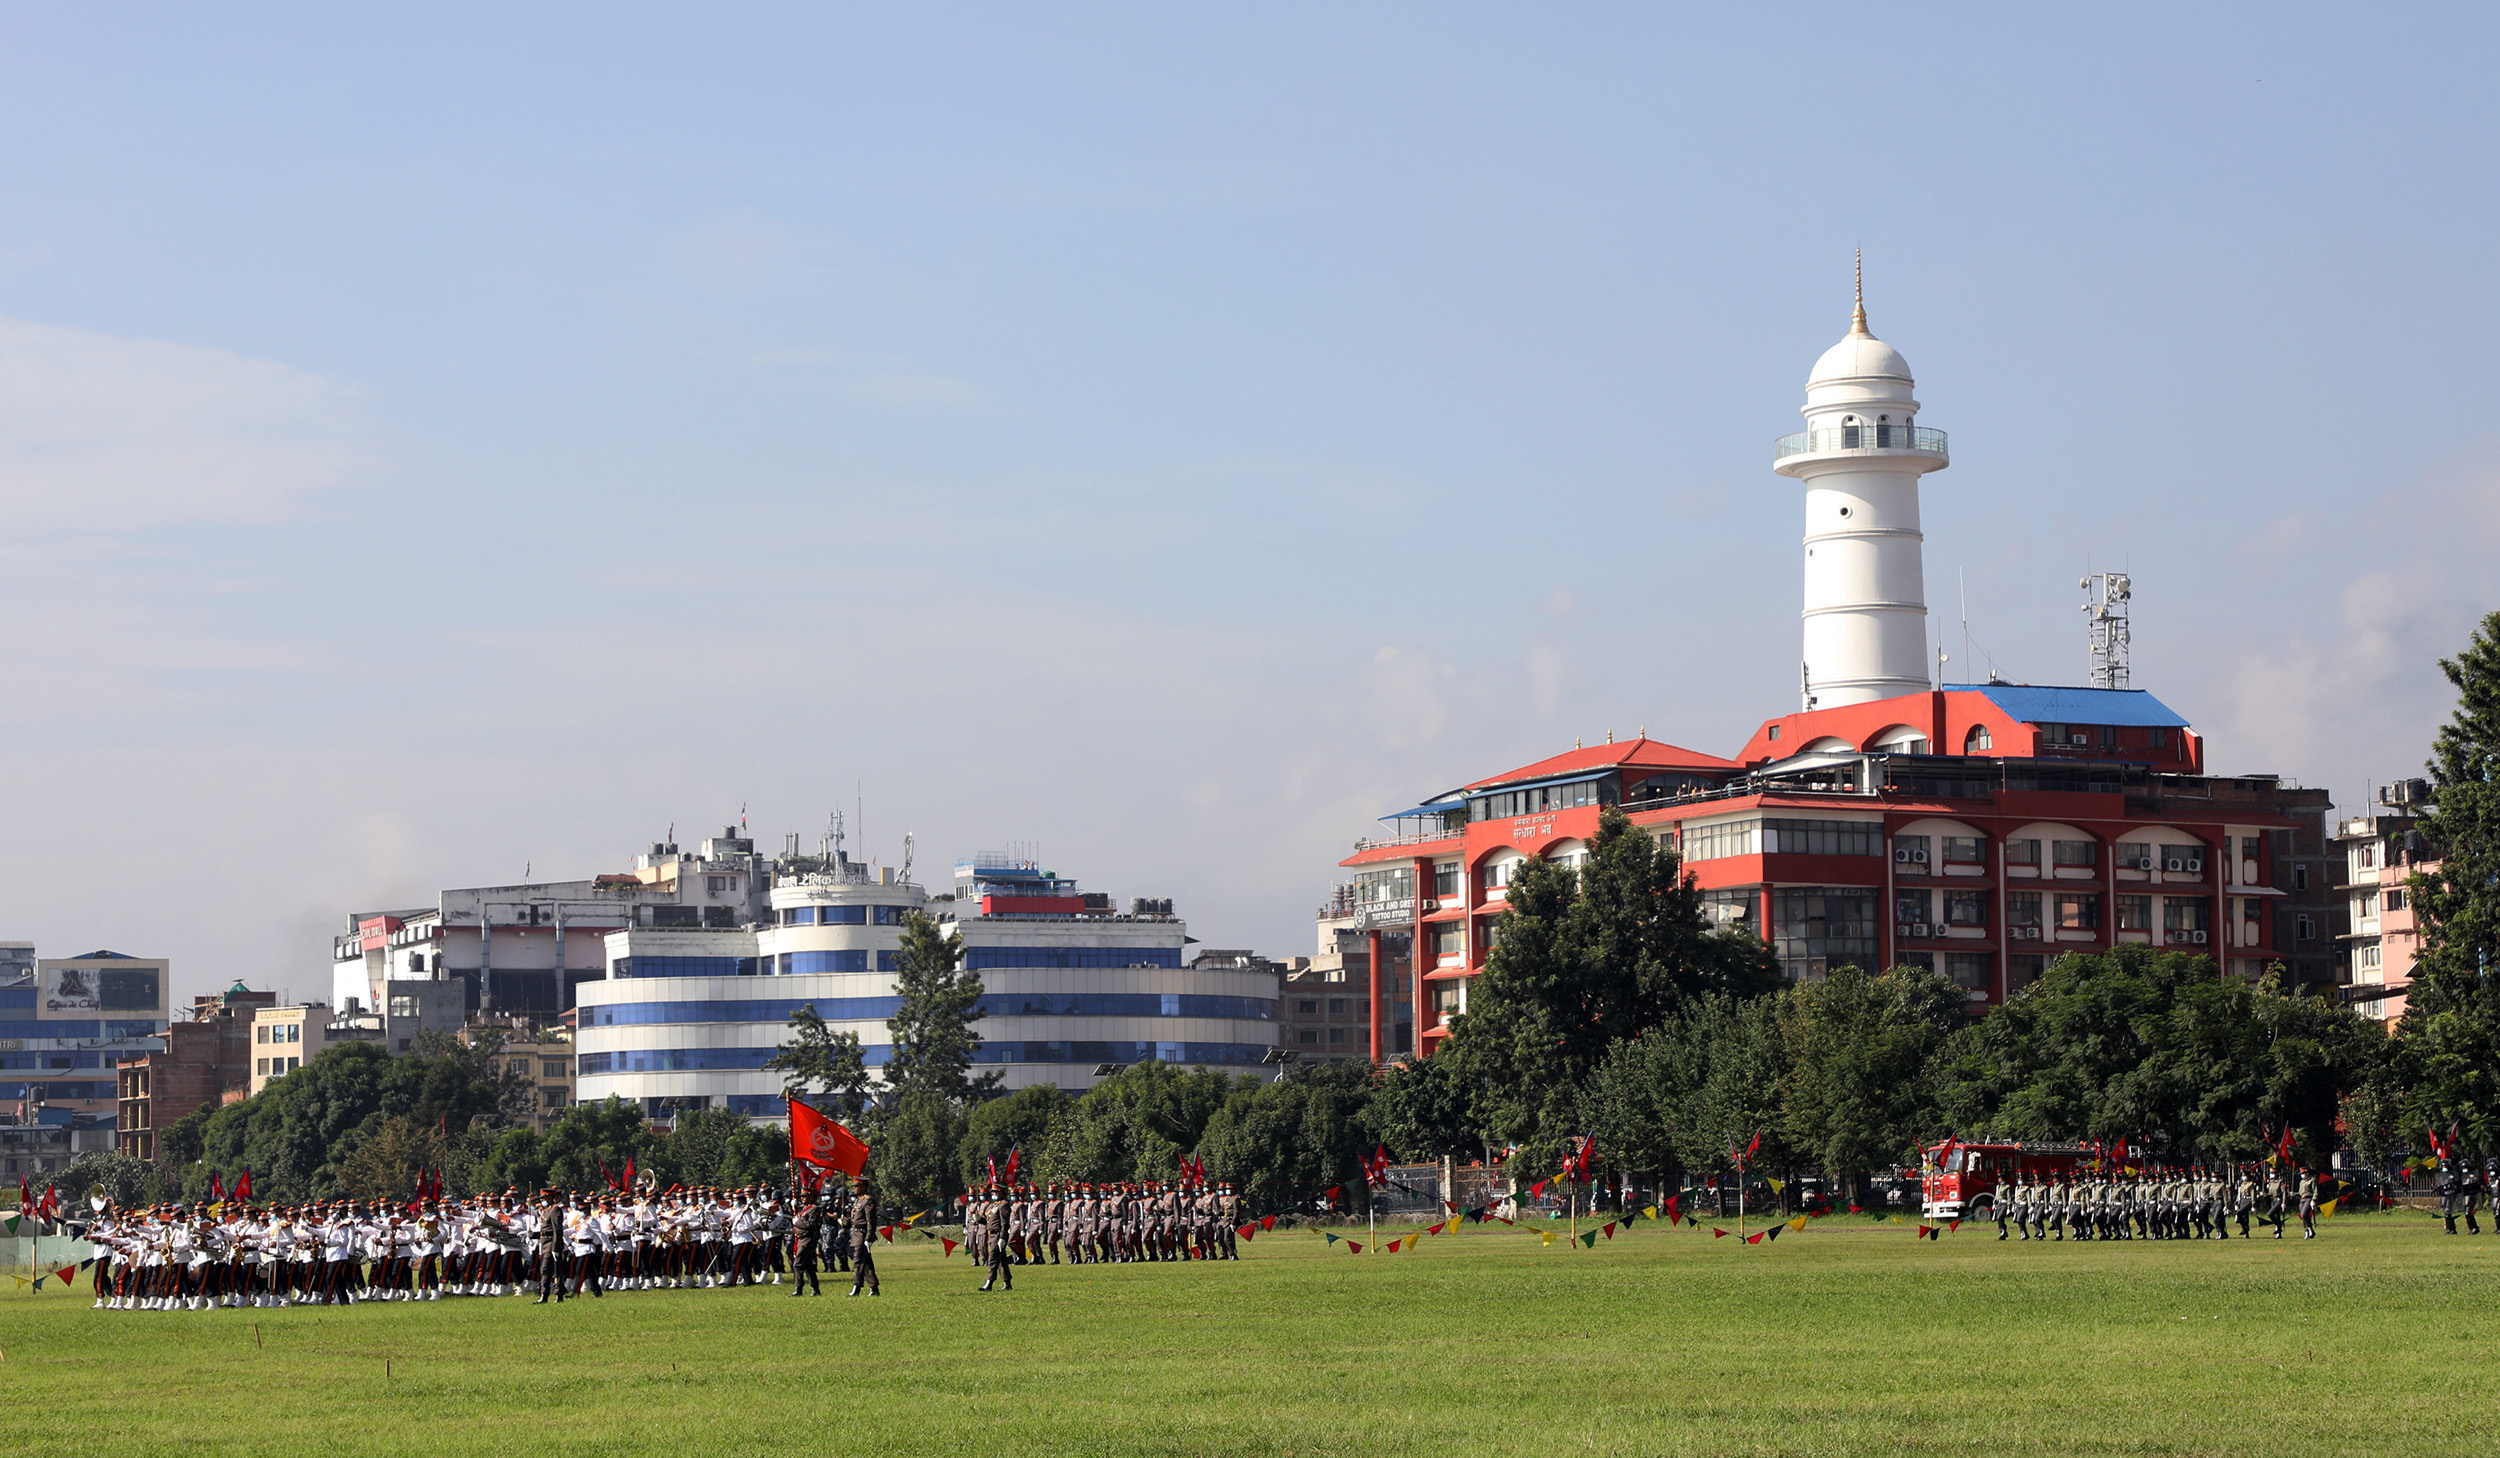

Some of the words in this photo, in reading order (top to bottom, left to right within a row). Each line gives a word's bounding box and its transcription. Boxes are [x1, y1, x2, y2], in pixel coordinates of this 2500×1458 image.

[1365, 902, 1385, 913] BLACK
[1386, 900, 1398, 910] AND
[1399, 899, 1415, 908] GREY
[1371, 911, 1391, 920] TATTOO
[1391, 909, 1410, 918] STUDIO
